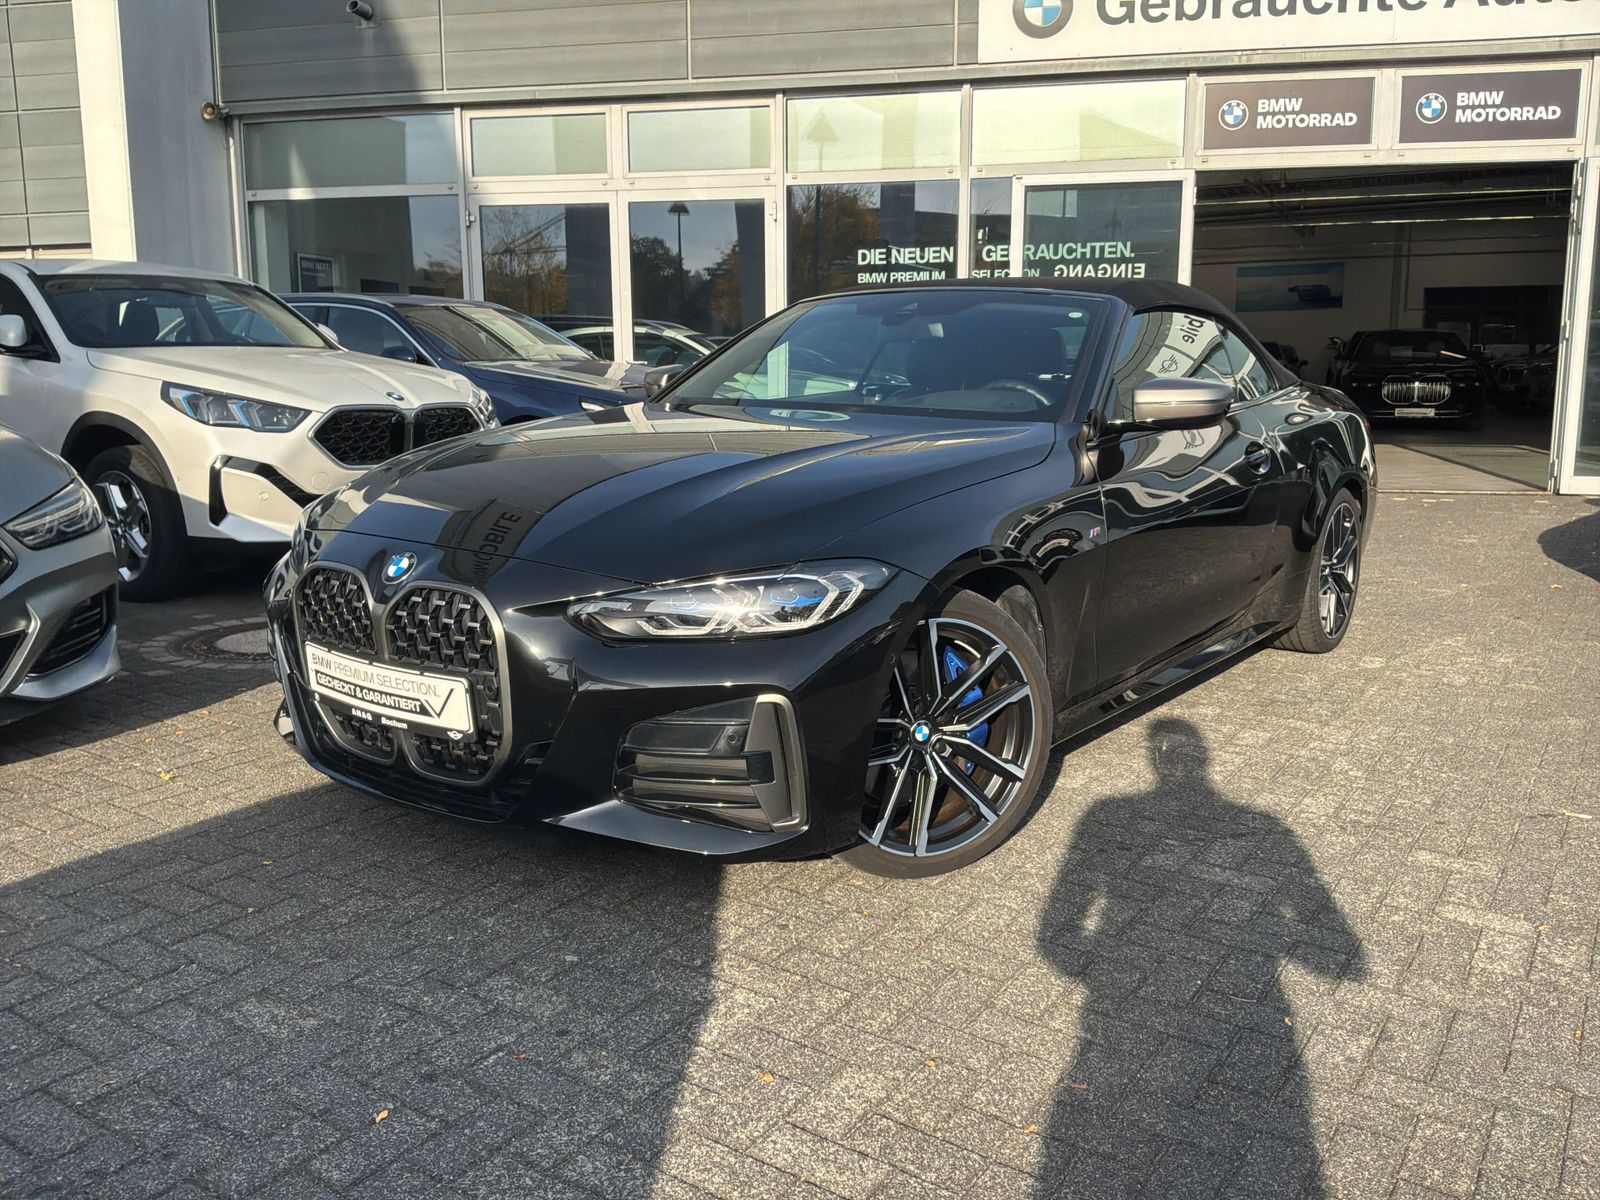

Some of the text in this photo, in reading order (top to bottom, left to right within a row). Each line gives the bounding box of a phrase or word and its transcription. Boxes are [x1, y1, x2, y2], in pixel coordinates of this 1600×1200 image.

[1096, 0, 1428, 26] Gebrauc
[1258, 97, 1303, 113] BMW
[1456, 91, 1504, 106] BMW
[1256, 113, 1358, 129] MOTORRAD
[1455, 106, 1562, 123] MOTORRAD
[857, 241, 1135, 265] DIE NEUEN GERAUCHTEN.
[857, 268, 1040, 284] BMW PREMIUM SELECON
[312, 653, 332, 670] BMW
[333, 662, 375, 684] PREMIUM
[317, 673, 421, 712] GECHECKT & GARANTIERT
[381, 716, 408, 730] Bochum
